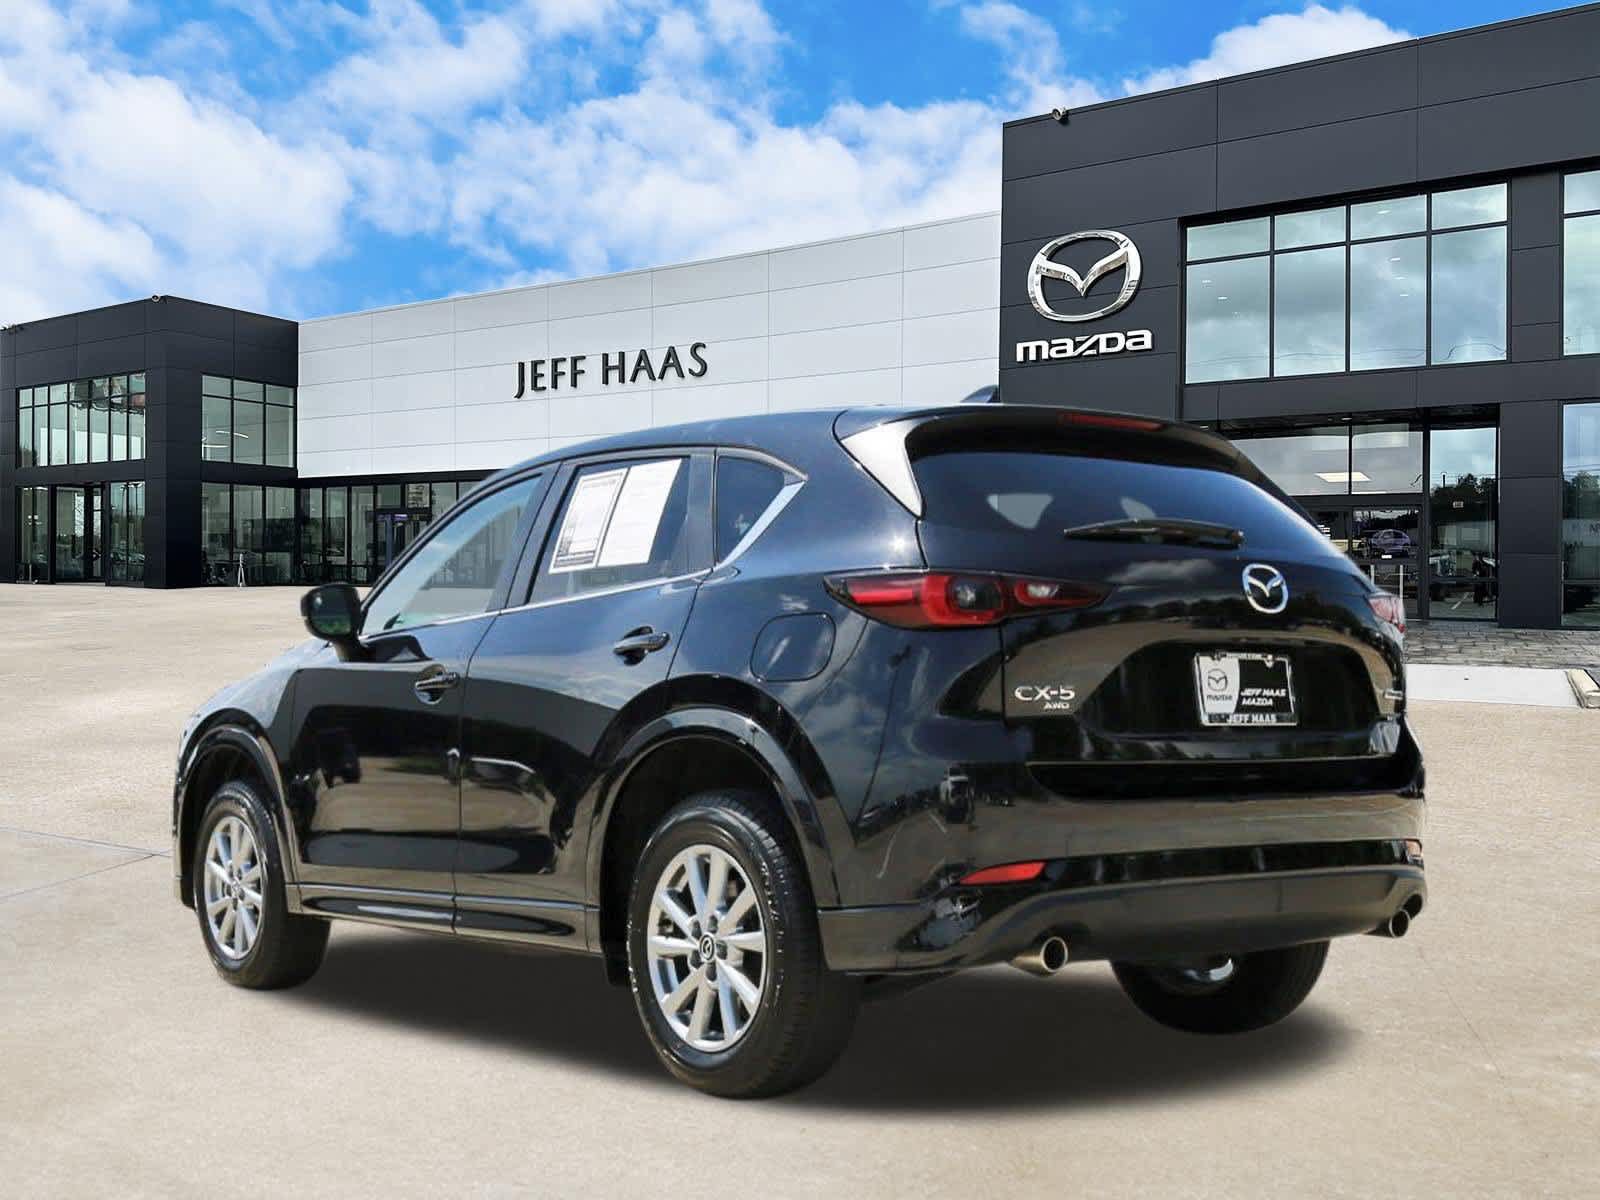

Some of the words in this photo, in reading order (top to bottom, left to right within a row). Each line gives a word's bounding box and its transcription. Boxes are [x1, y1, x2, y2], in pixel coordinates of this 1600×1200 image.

[1016, 329, 1153, 362] mazda
[513, 355, 587, 399] JEFF
[601, 341, 708, 386] HAAS
[1014, 685, 1076, 701] CX-5
[1240, 688, 1262, 697] JEFF
[1043, 702, 1070, 710] AWD
[1241, 698, 1274, 706] MAZDA
[1226, 714, 1250, 723] JEFF
